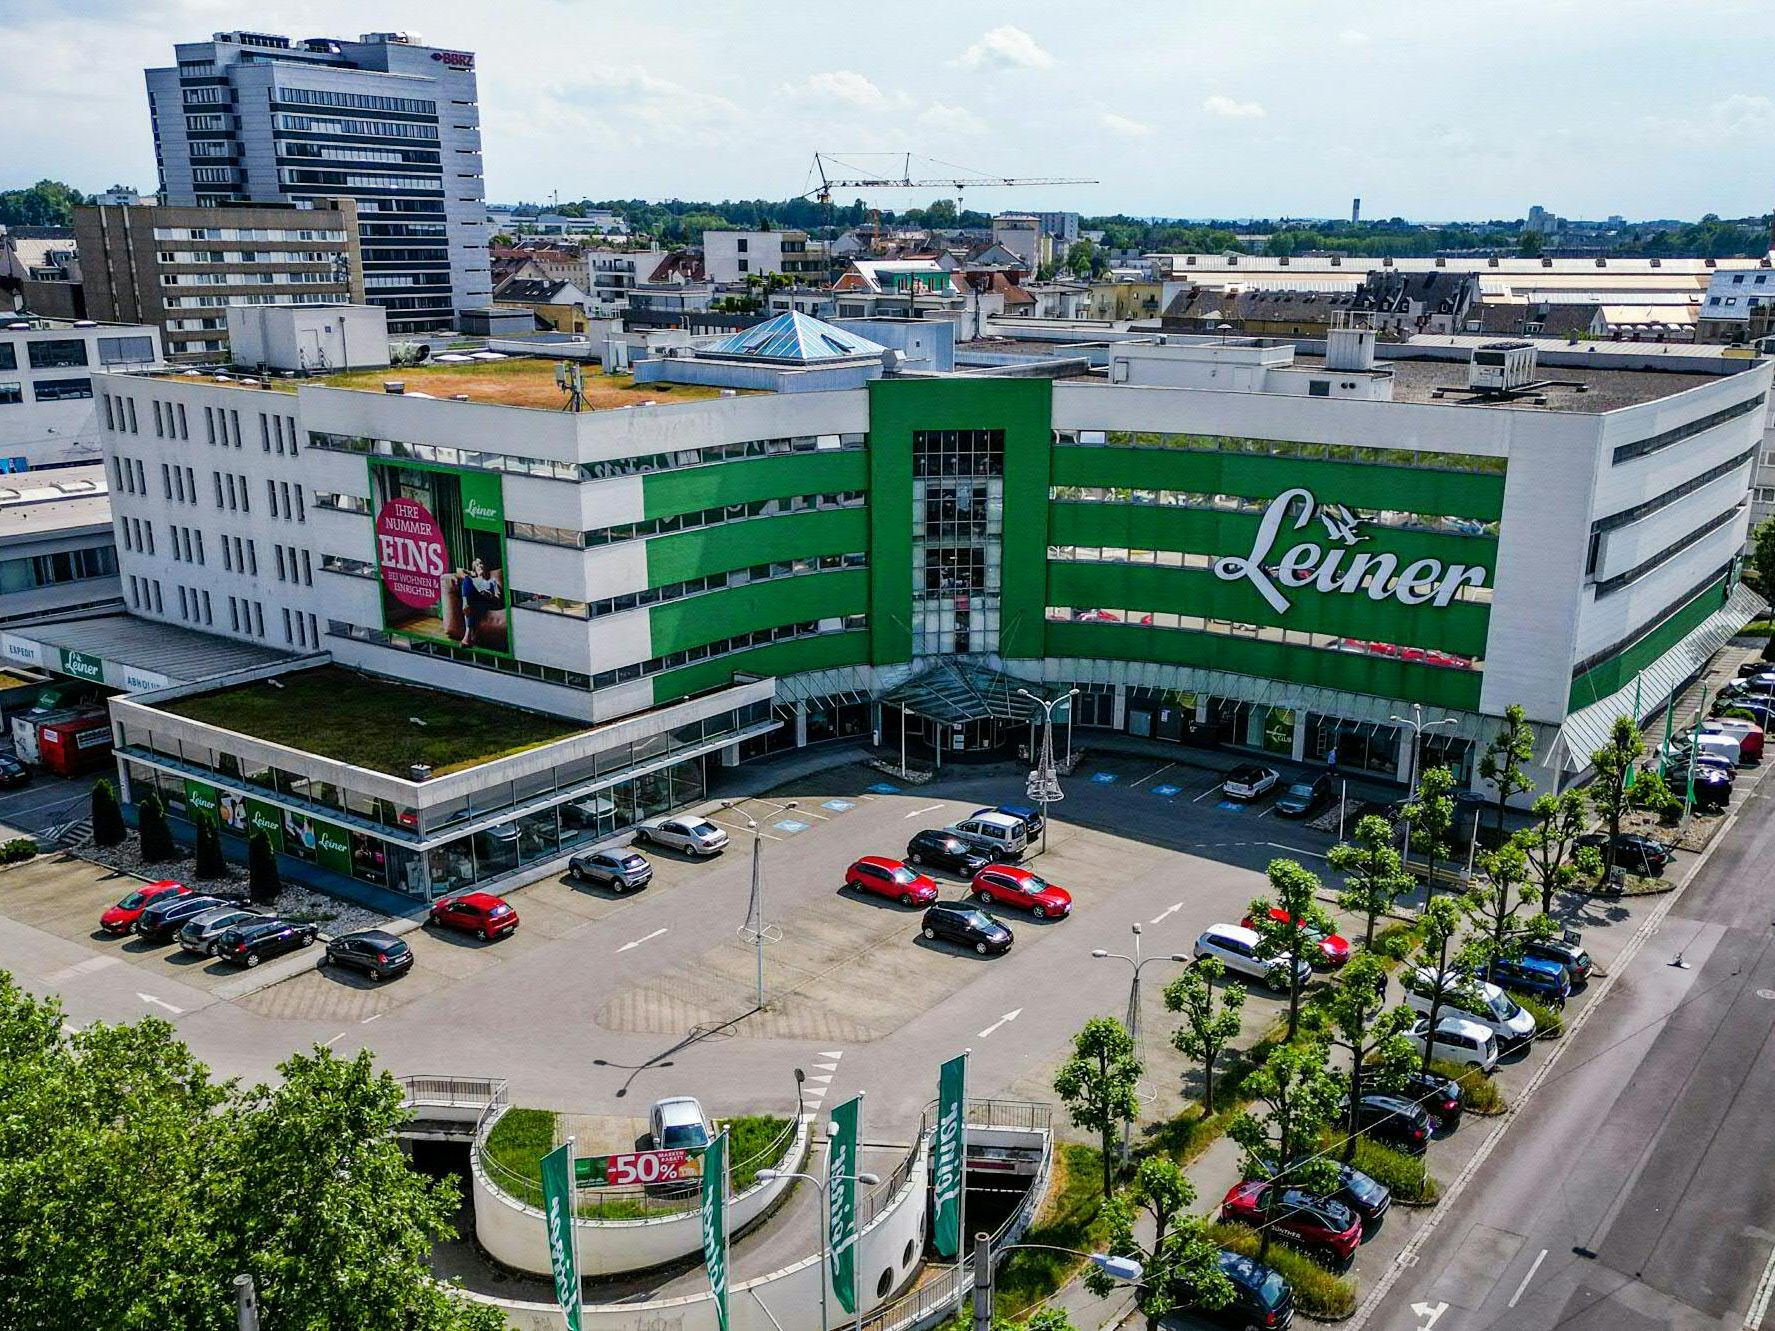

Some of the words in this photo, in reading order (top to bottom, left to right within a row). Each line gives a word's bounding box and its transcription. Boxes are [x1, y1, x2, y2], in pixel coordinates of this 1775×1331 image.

[443, 52, 473, 66] BBRZ
[395, 503, 419, 519] IHRE
[464, 498, 497, 518] Leiner
[385, 517, 432, 536] NUMMER
[378, 534, 444, 577] EINS
[1214, 488, 1487, 615] Leiner
[388, 571, 399, 581] BEI
[399, 573, 432, 588] WOHNEN
[394, 582, 435, 598] EINRICHTEN
[64, 650, 99, 676] Leiner
[189, 791, 216, 809] Leiner
[252, 811, 279, 830] Leiner
[318, 832, 348, 852] Leiner
